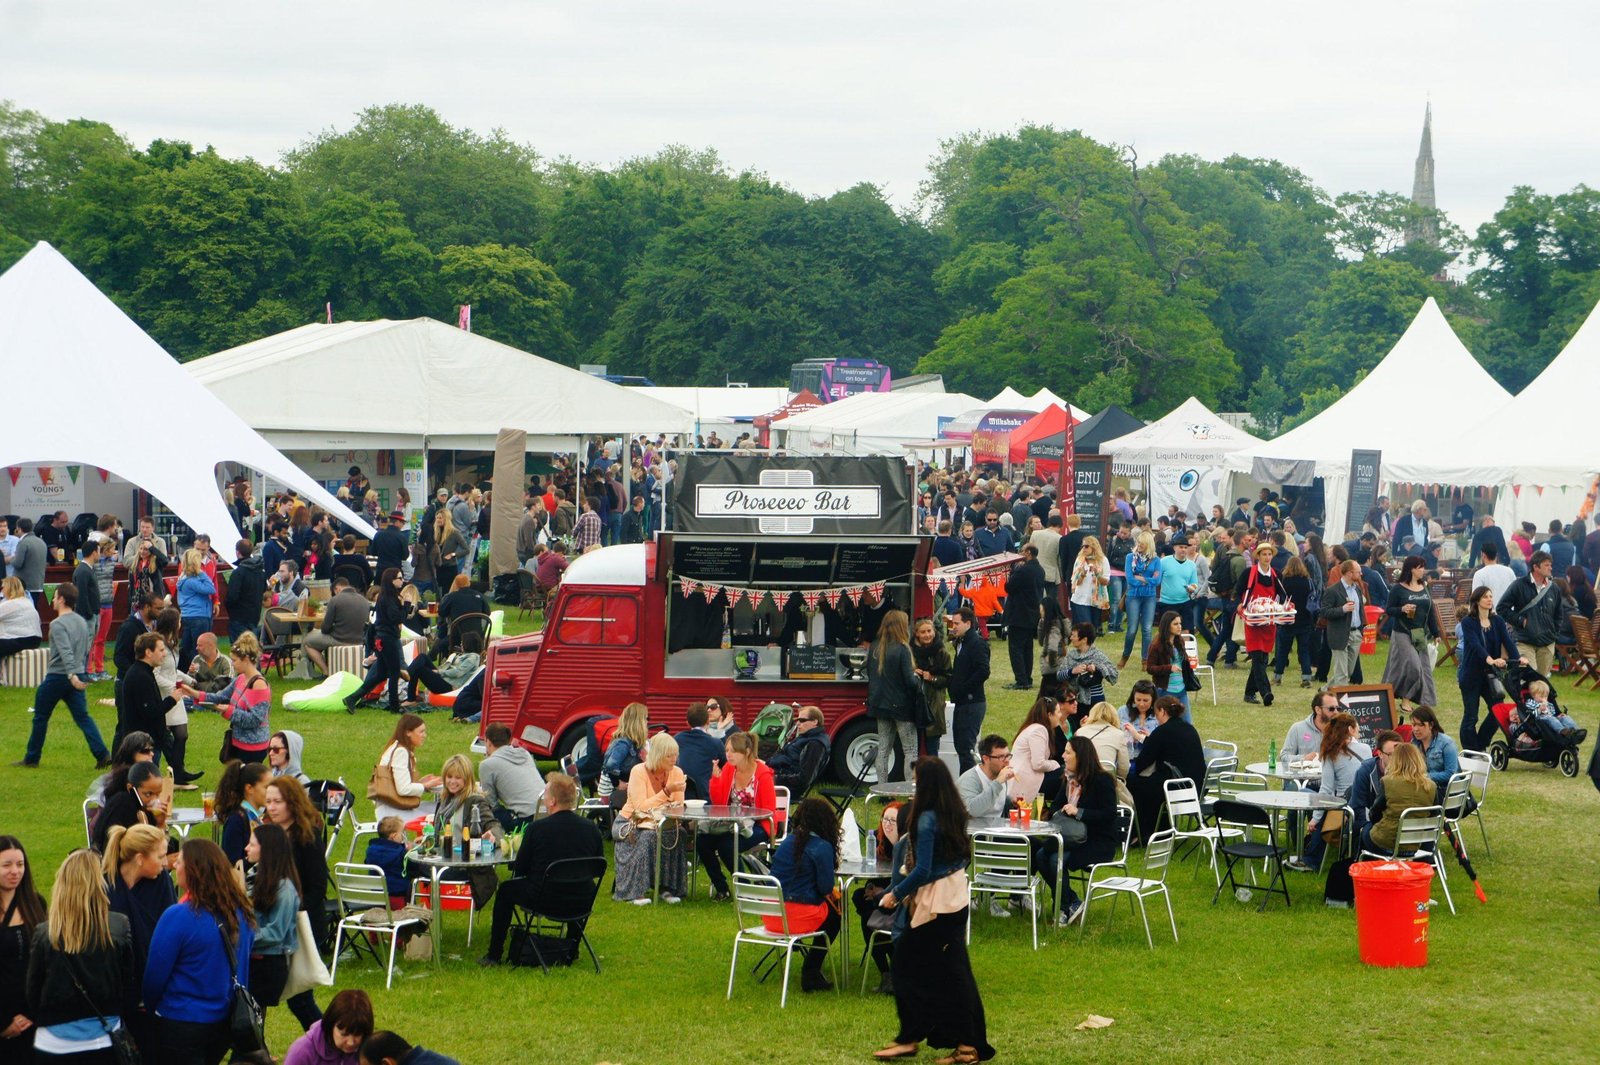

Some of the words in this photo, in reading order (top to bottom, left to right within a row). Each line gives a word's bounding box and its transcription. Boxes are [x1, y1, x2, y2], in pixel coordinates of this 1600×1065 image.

[1155, 452, 1178, 461] Liquid
[1180, 452, 1214, 461] Nitrogen
[1357, 464, 1373, 477] FOOD
[1075, 471, 1101, 485] ENU
[724, 490, 810, 511] Prosecco
[814, 490, 852, 511] Bar
